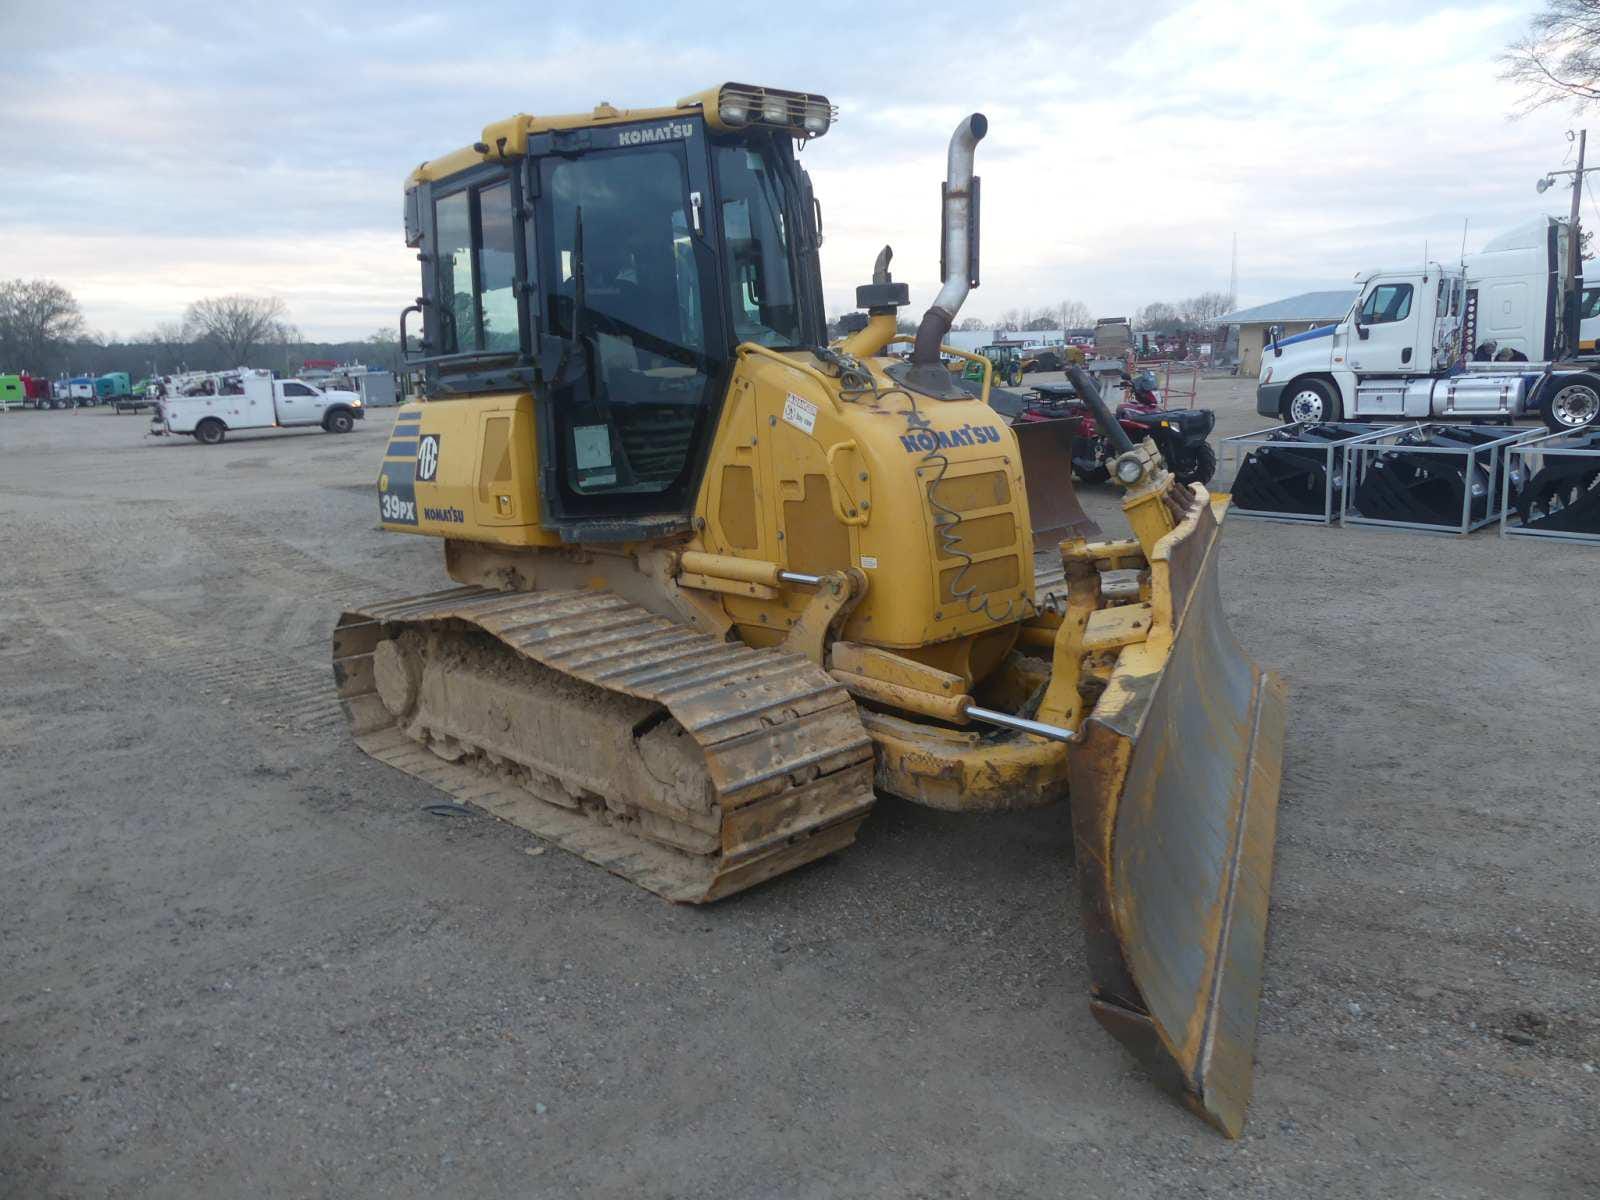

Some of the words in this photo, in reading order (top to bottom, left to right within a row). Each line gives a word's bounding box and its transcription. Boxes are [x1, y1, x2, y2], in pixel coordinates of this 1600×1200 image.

[619, 122, 693, 145] KOMATSU
[900, 424, 1000, 453] KOMATSU
[382, 494, 415, 520] 39PX
[424, 506, 464, 523] KOMATSU
